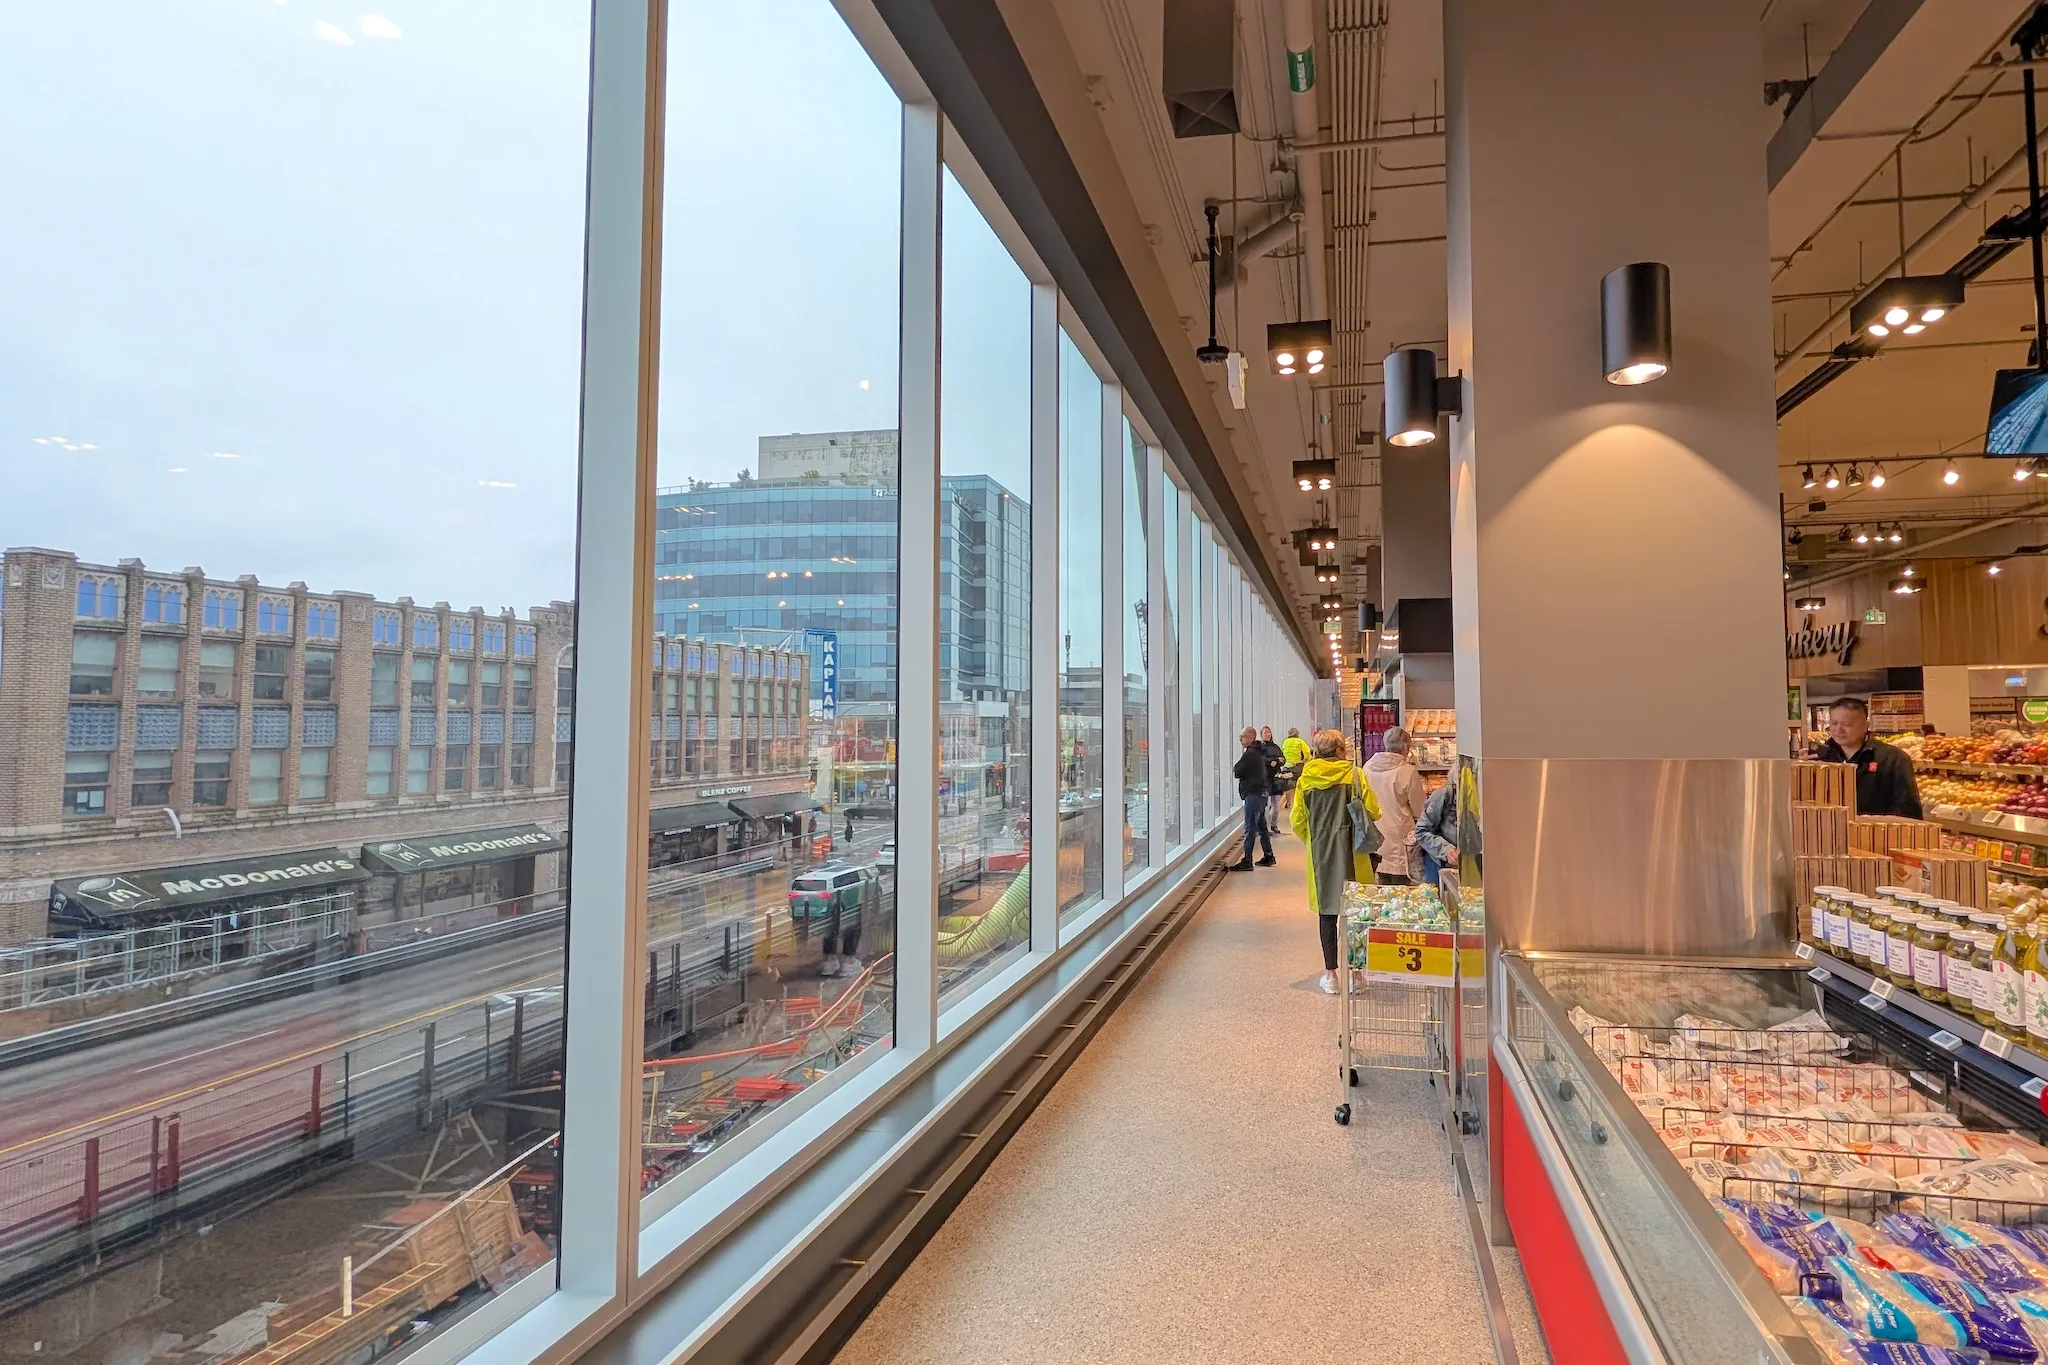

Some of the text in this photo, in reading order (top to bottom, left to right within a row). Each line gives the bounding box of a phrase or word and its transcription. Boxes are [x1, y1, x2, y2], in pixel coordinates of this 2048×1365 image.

[1787, 613, 1855, 665] akery
[823, 640, 835, 720] KAPLAN
[701, 785, 752, 797] BLENZ COFFEE
[429, 831, 552, 859] McDonald's
[161, 858, 355, 896] McDonald's
[1396, 931, 1427, 946] SALE
[1398, 946, 1422, 972] $3
